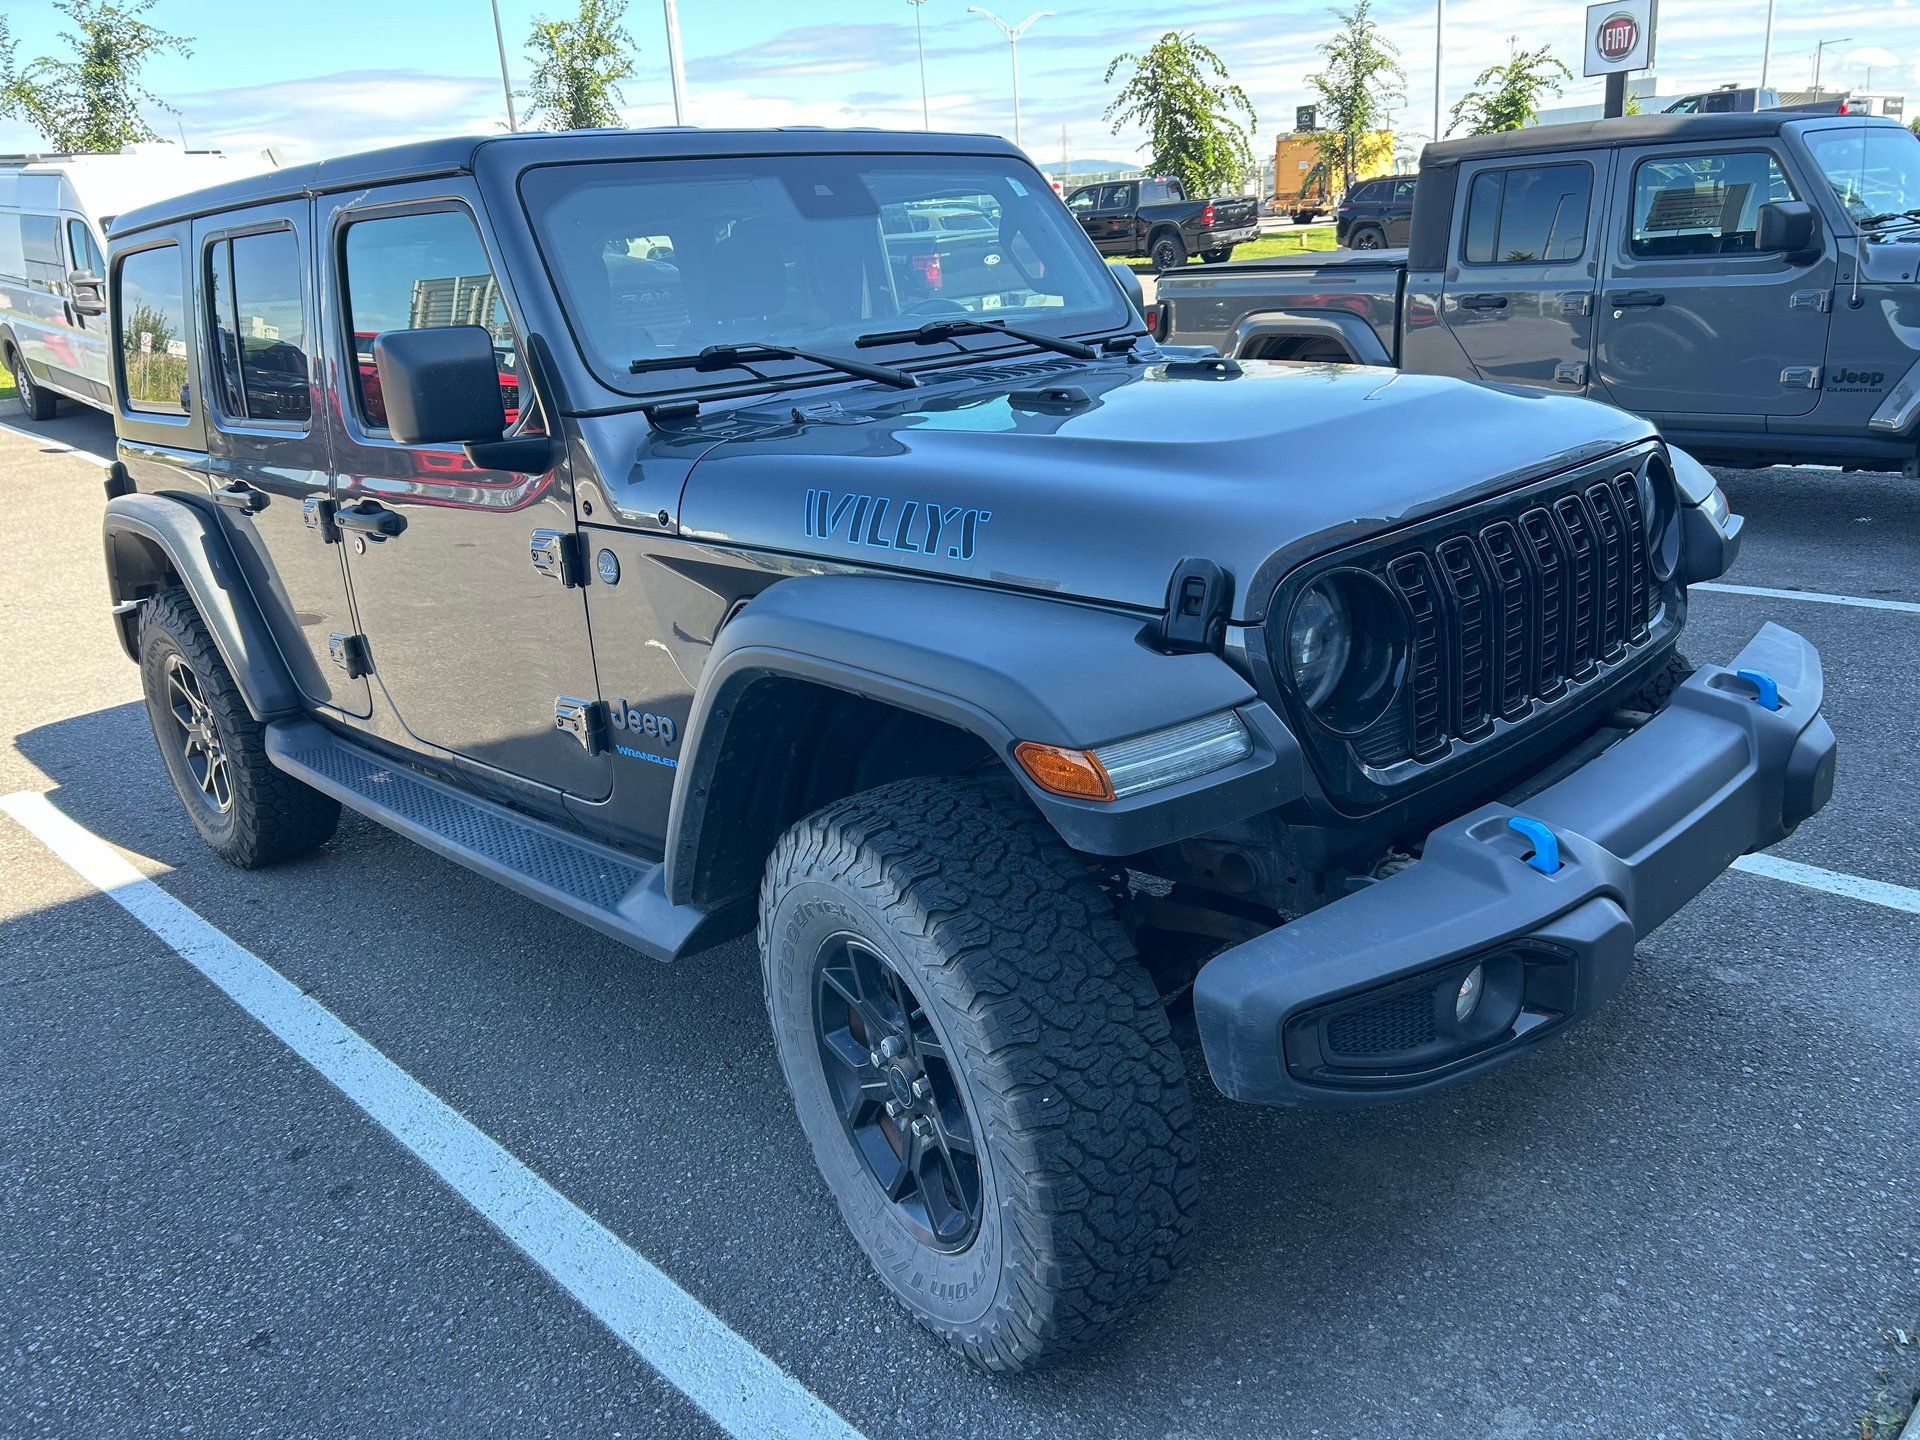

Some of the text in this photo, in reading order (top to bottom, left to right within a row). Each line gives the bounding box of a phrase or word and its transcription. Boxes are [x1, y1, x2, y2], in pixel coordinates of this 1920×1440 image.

[1605, 25, 1631, 51] FIAT
[1832, 368, 1884, 386] Jeep
[804, 488, 992, 560] WILLYS
[610, 699, 677, 747] Jeep
[616, 744, 679, 768] WRANGLER
